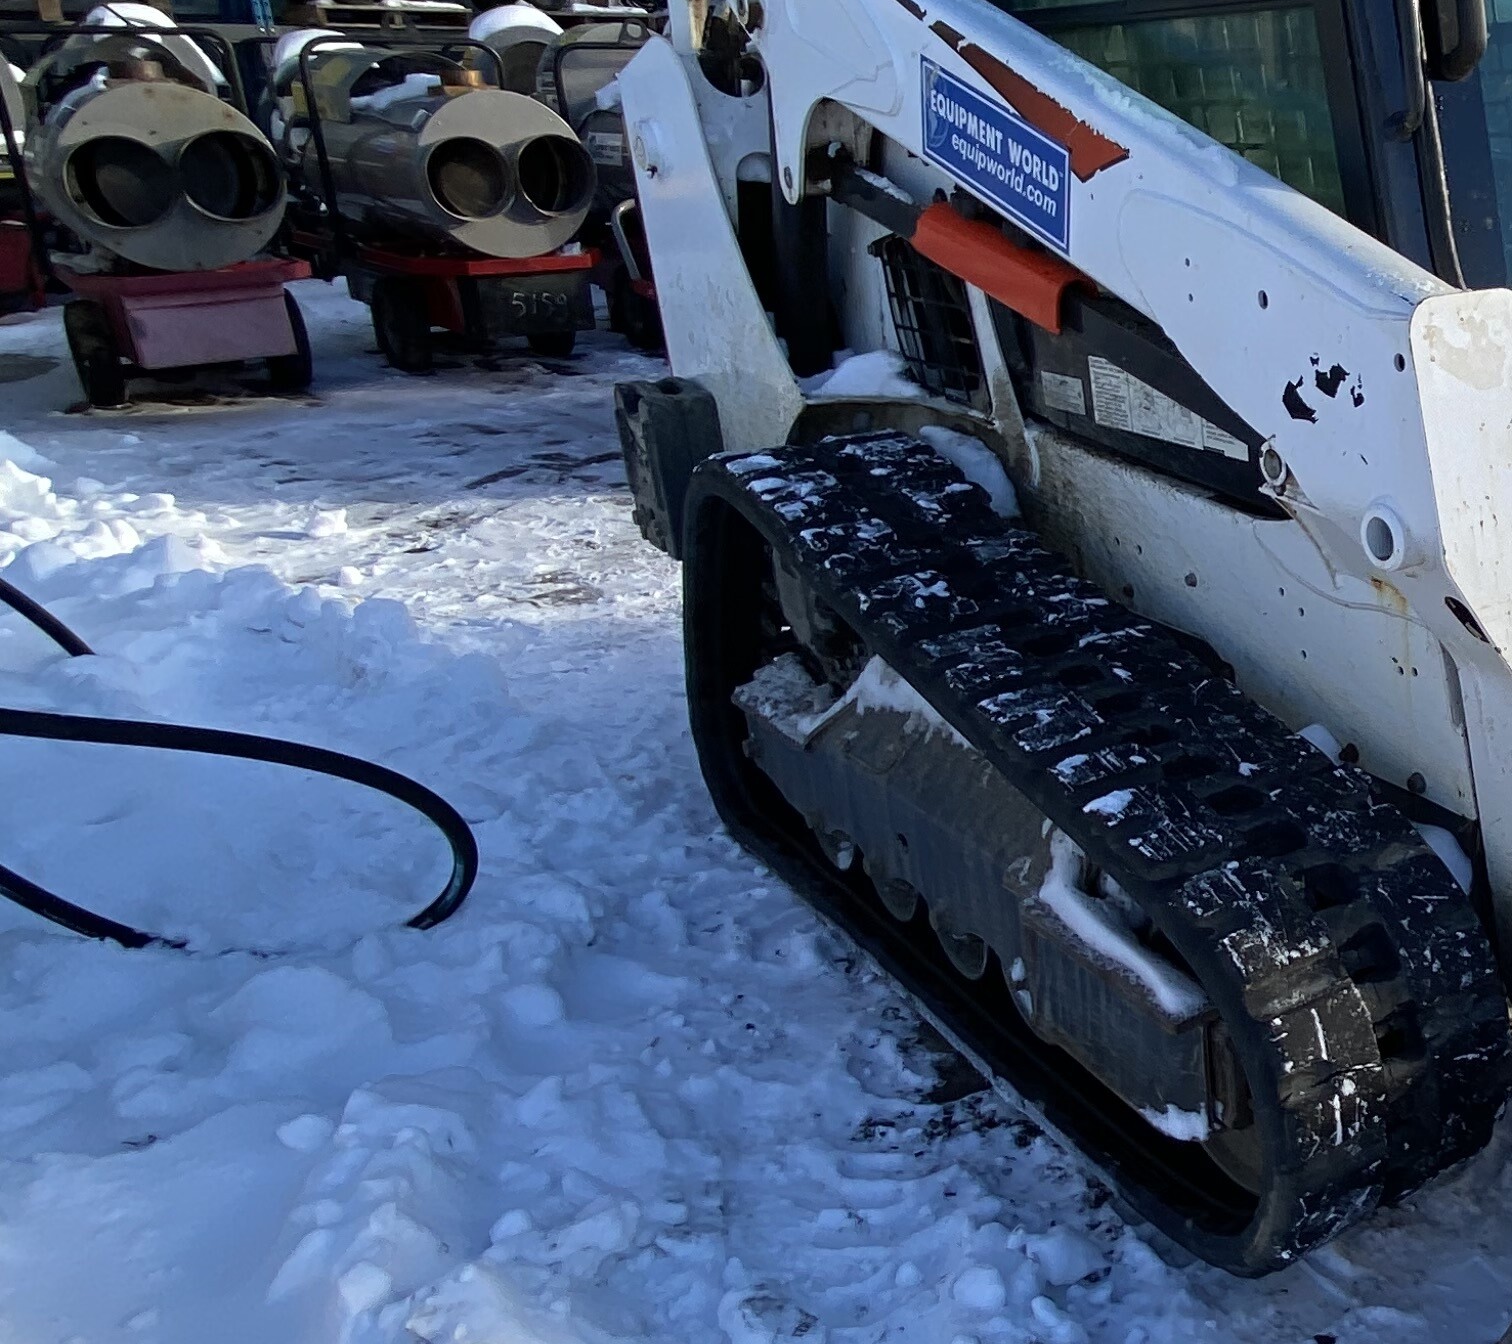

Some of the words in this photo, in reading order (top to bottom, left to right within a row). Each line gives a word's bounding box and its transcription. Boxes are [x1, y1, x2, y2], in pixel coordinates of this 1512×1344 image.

[930, 89, 1003, 154] EQUIPMENT
[1008, 138, 1059, 191] WORLD
[952, 134, 1057, 217] equipworld.com
